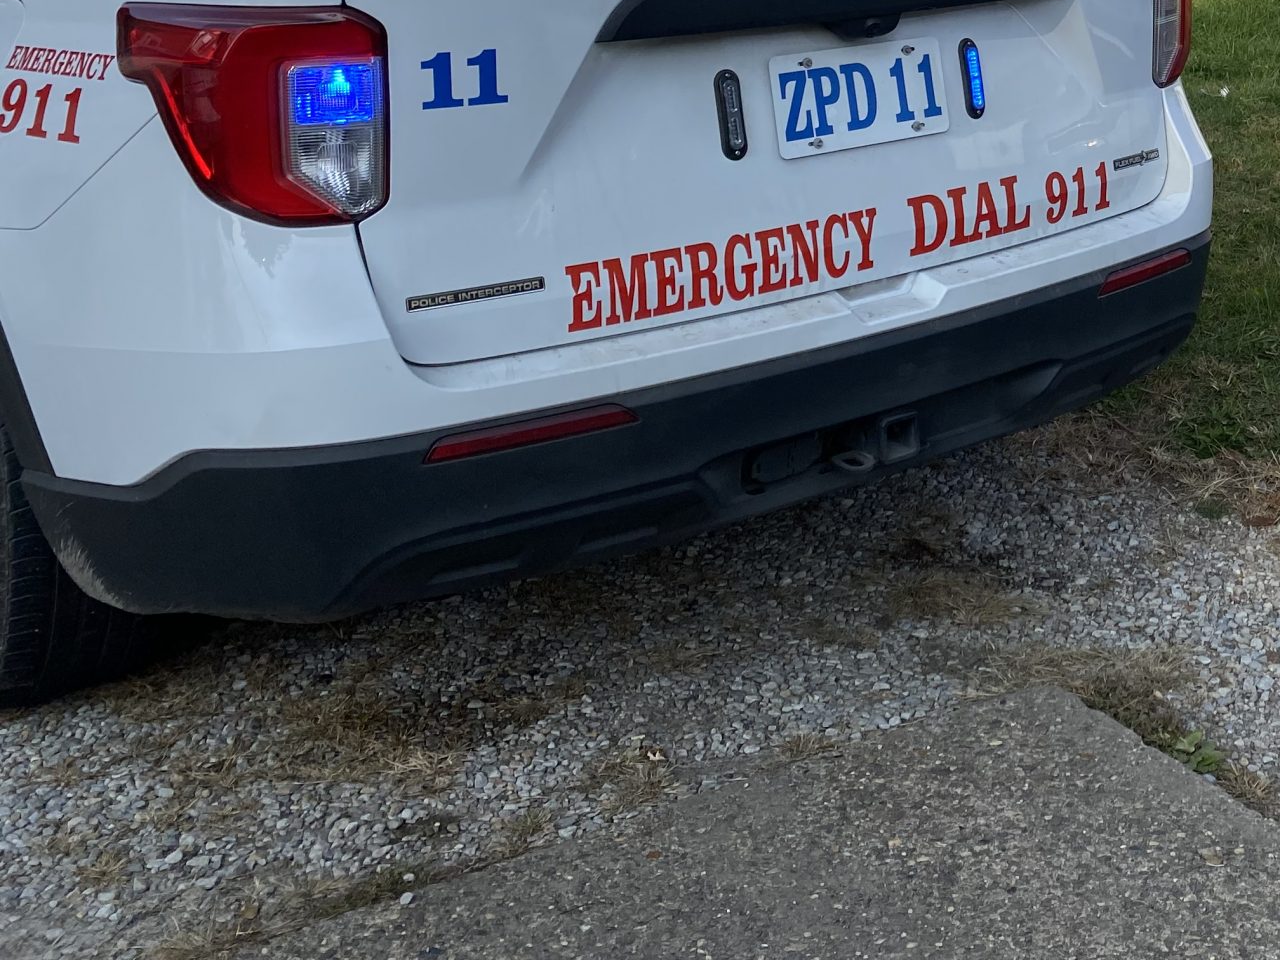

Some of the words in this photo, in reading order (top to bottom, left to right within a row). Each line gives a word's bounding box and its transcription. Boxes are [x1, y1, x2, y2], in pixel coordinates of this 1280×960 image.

[5, 45, 115, 81] EMERGENCY
[420, 48, 509, 110] 11
[0, 78, 83, 144] 911
[778, 62, 877, 142] ZPD
[889, 53, 943, 123] 11
[565, 207, 877, 333] EMERGENCY
[906, 175, 1031, 257] DIAL
[1043, 161, 1112, 224] 911
[411, 294, 455, 309] POLICE
[458, 280, 541, 301] INTERCEPTOR
